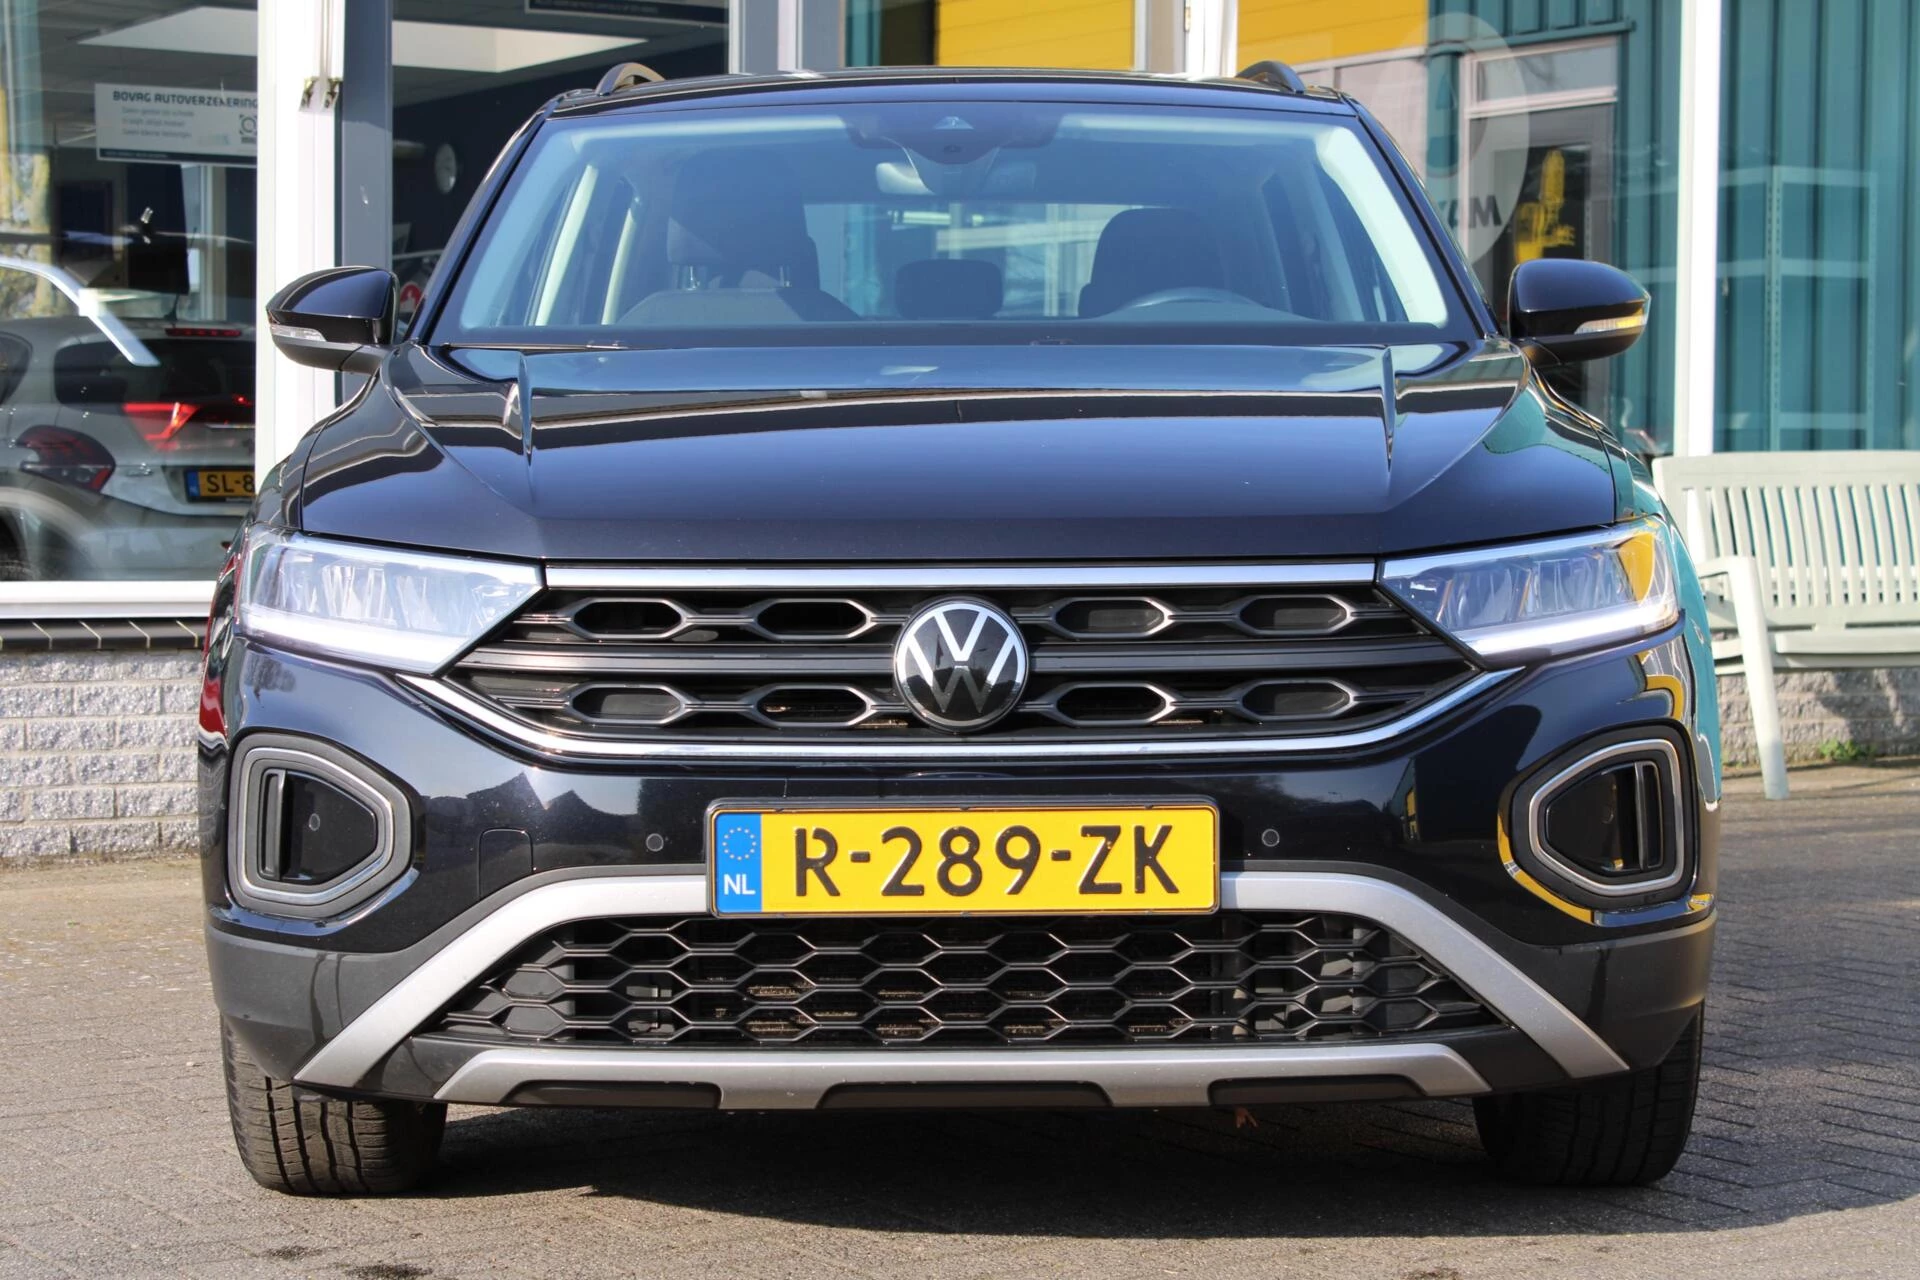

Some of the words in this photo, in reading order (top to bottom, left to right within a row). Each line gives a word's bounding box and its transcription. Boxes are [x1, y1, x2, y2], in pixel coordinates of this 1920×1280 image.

[113, 90, 152, 103] BOVAG
[796, 826, 1178, 896] R-289-ZK
[724, 874, 755, 894] NL
